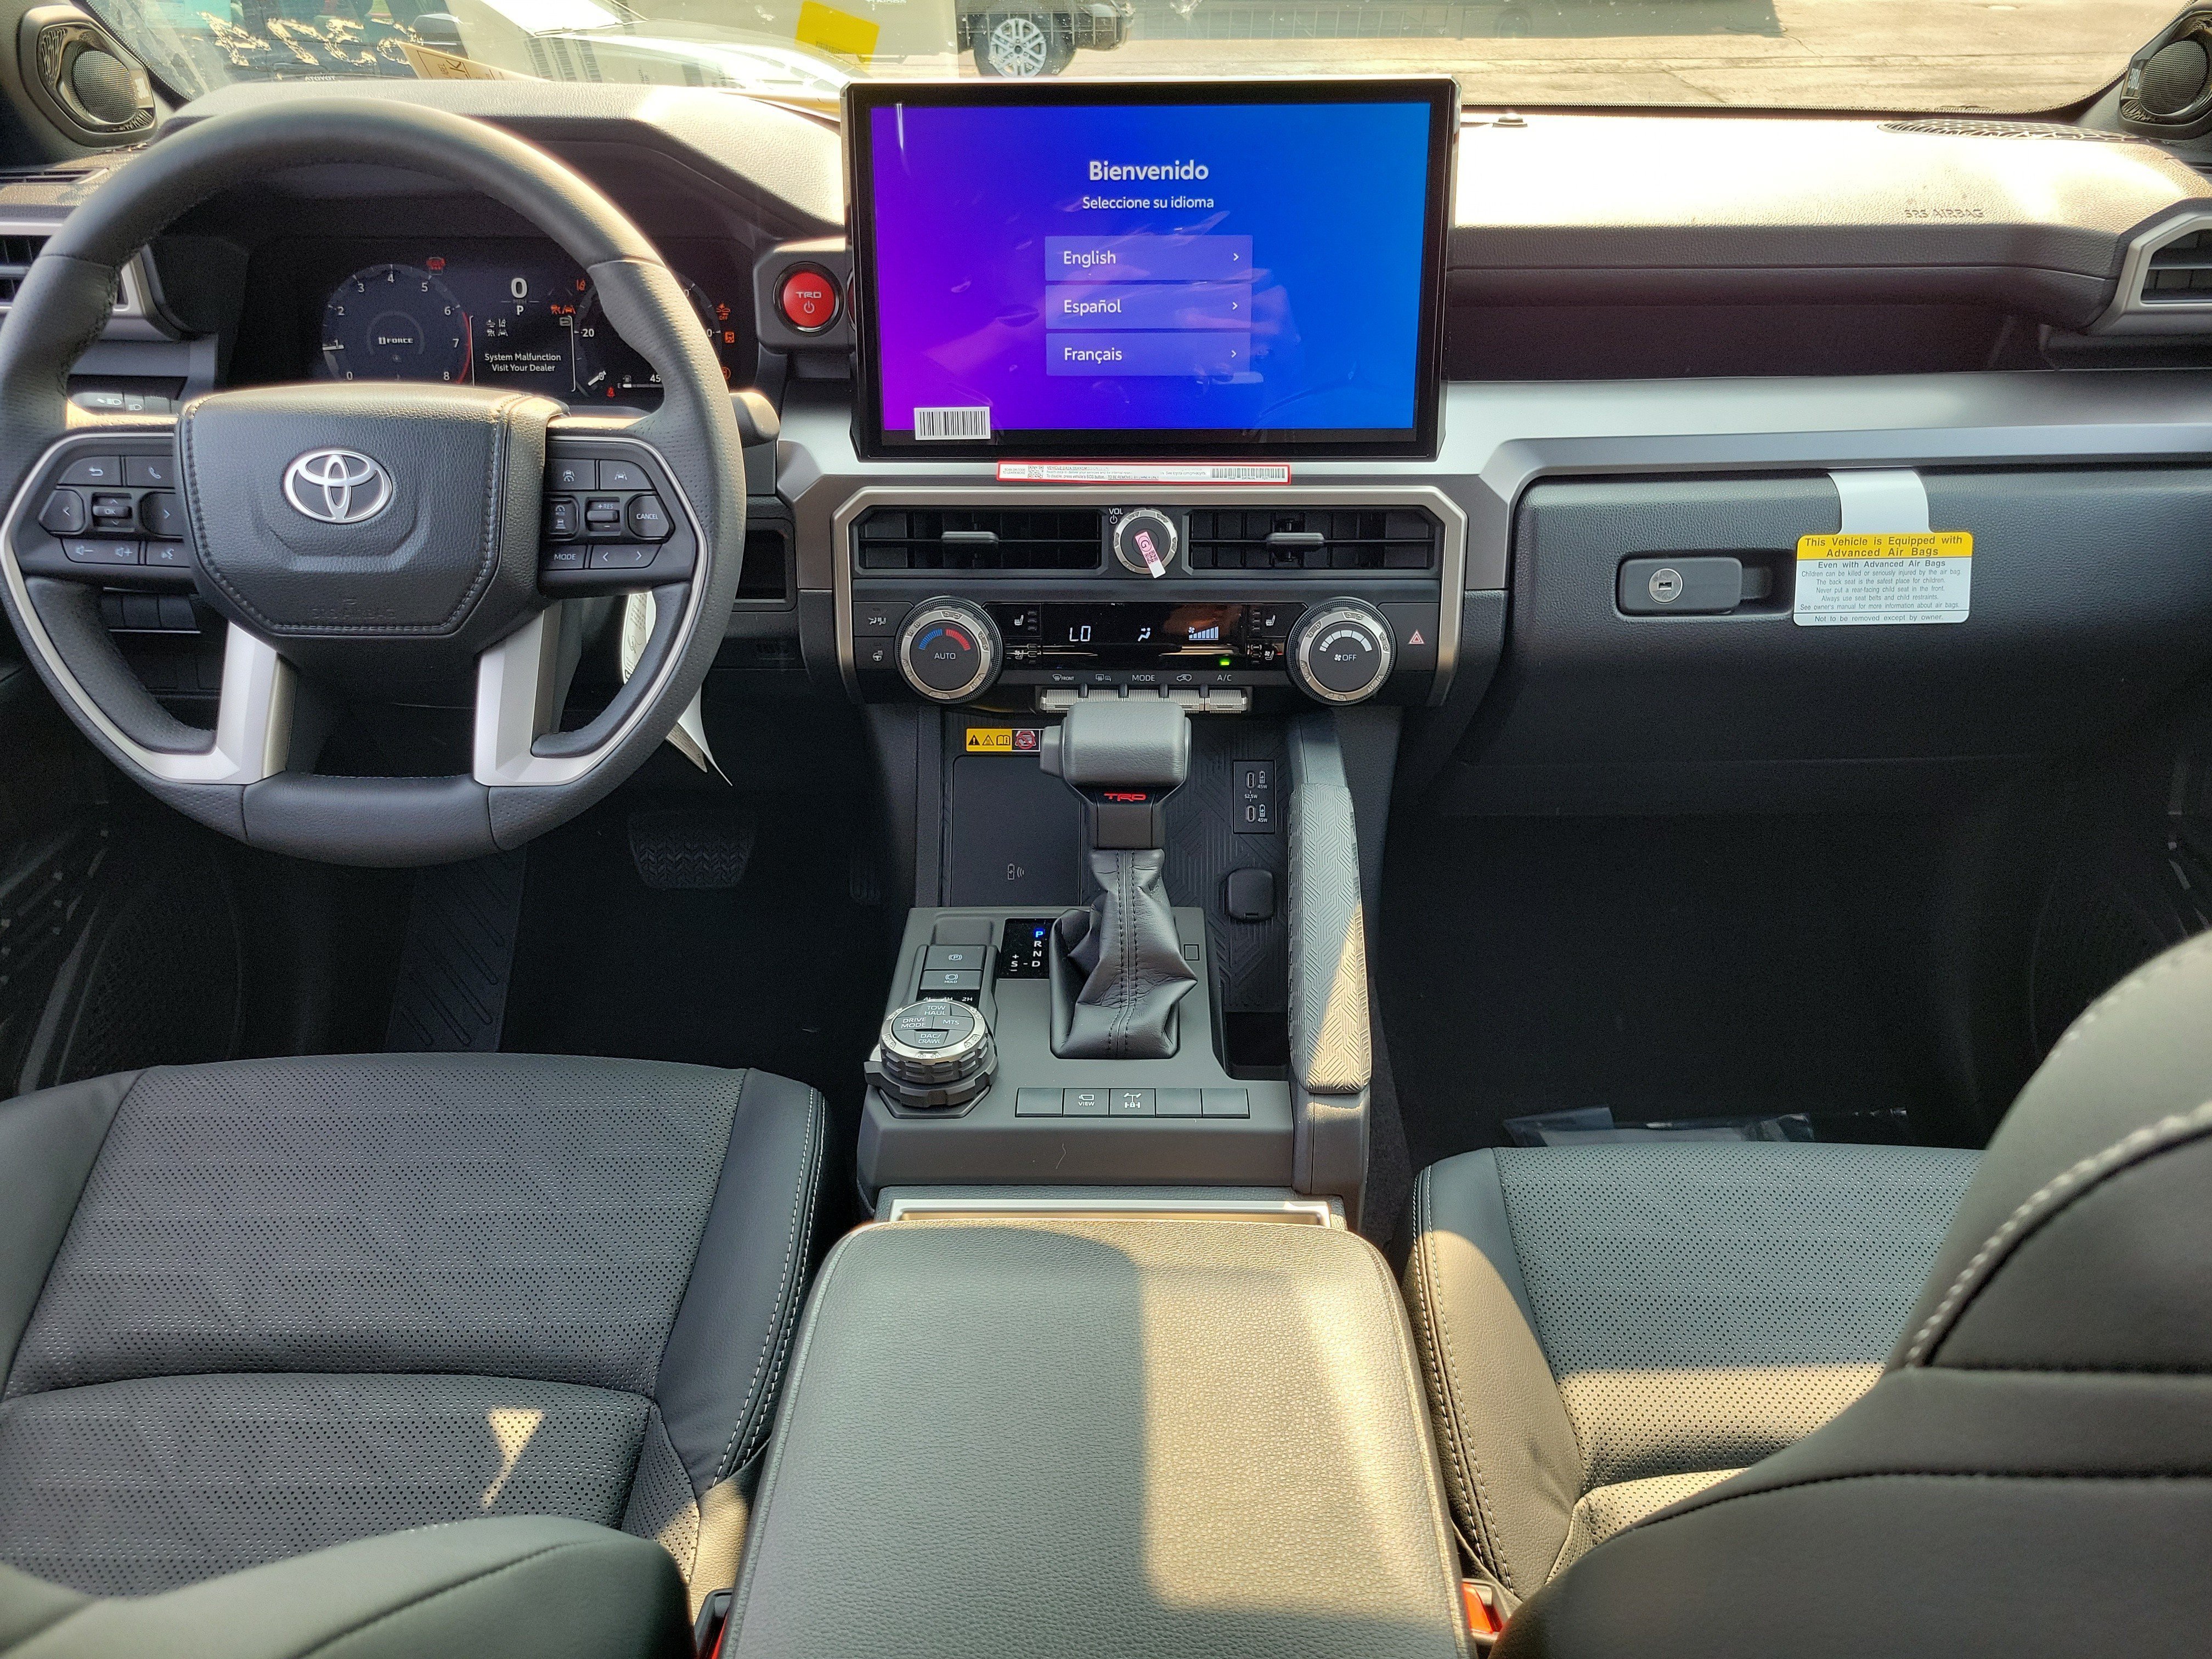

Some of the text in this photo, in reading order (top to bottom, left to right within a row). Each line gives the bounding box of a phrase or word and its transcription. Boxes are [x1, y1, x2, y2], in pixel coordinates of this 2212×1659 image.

[1089, 159, 1209, 180] Bienvenido
[1082, 196, 1215, 210] Seleccione su idioma
[1933, 208, 1984, 218] AIRBAG
[1063, 250, 1116, 268] English
[387, 274, 394, 283] 4
[358, 283, 365, 292] 3
[421, 283, 428, 292] 5
[511, 278, 528, 298] 0
[338, 307, 345, 315] 2
[444, 306, 451, 315] 6
[516, 305, 524, 315] P
[1063, 299, 1122, 316] Español
[582, 329, 595, 337] 20
[453, 338, 459, 348] 7
[484, 353, 561, 363] System Malfunction
[1064, 347, 1122, 364] Français
[347, 371, 353, 380] 0
[443, 371, 450, 381] 8
[598, 372, 605, 381] 0
[1805, 535, 1962, 546] This Vehicle is Equipped with
[1826, 546, 1938, 557] Advanced Air Bags
[1069, 625, 1091, 642] LO
[1103, 793, 1146, 802] TRD
